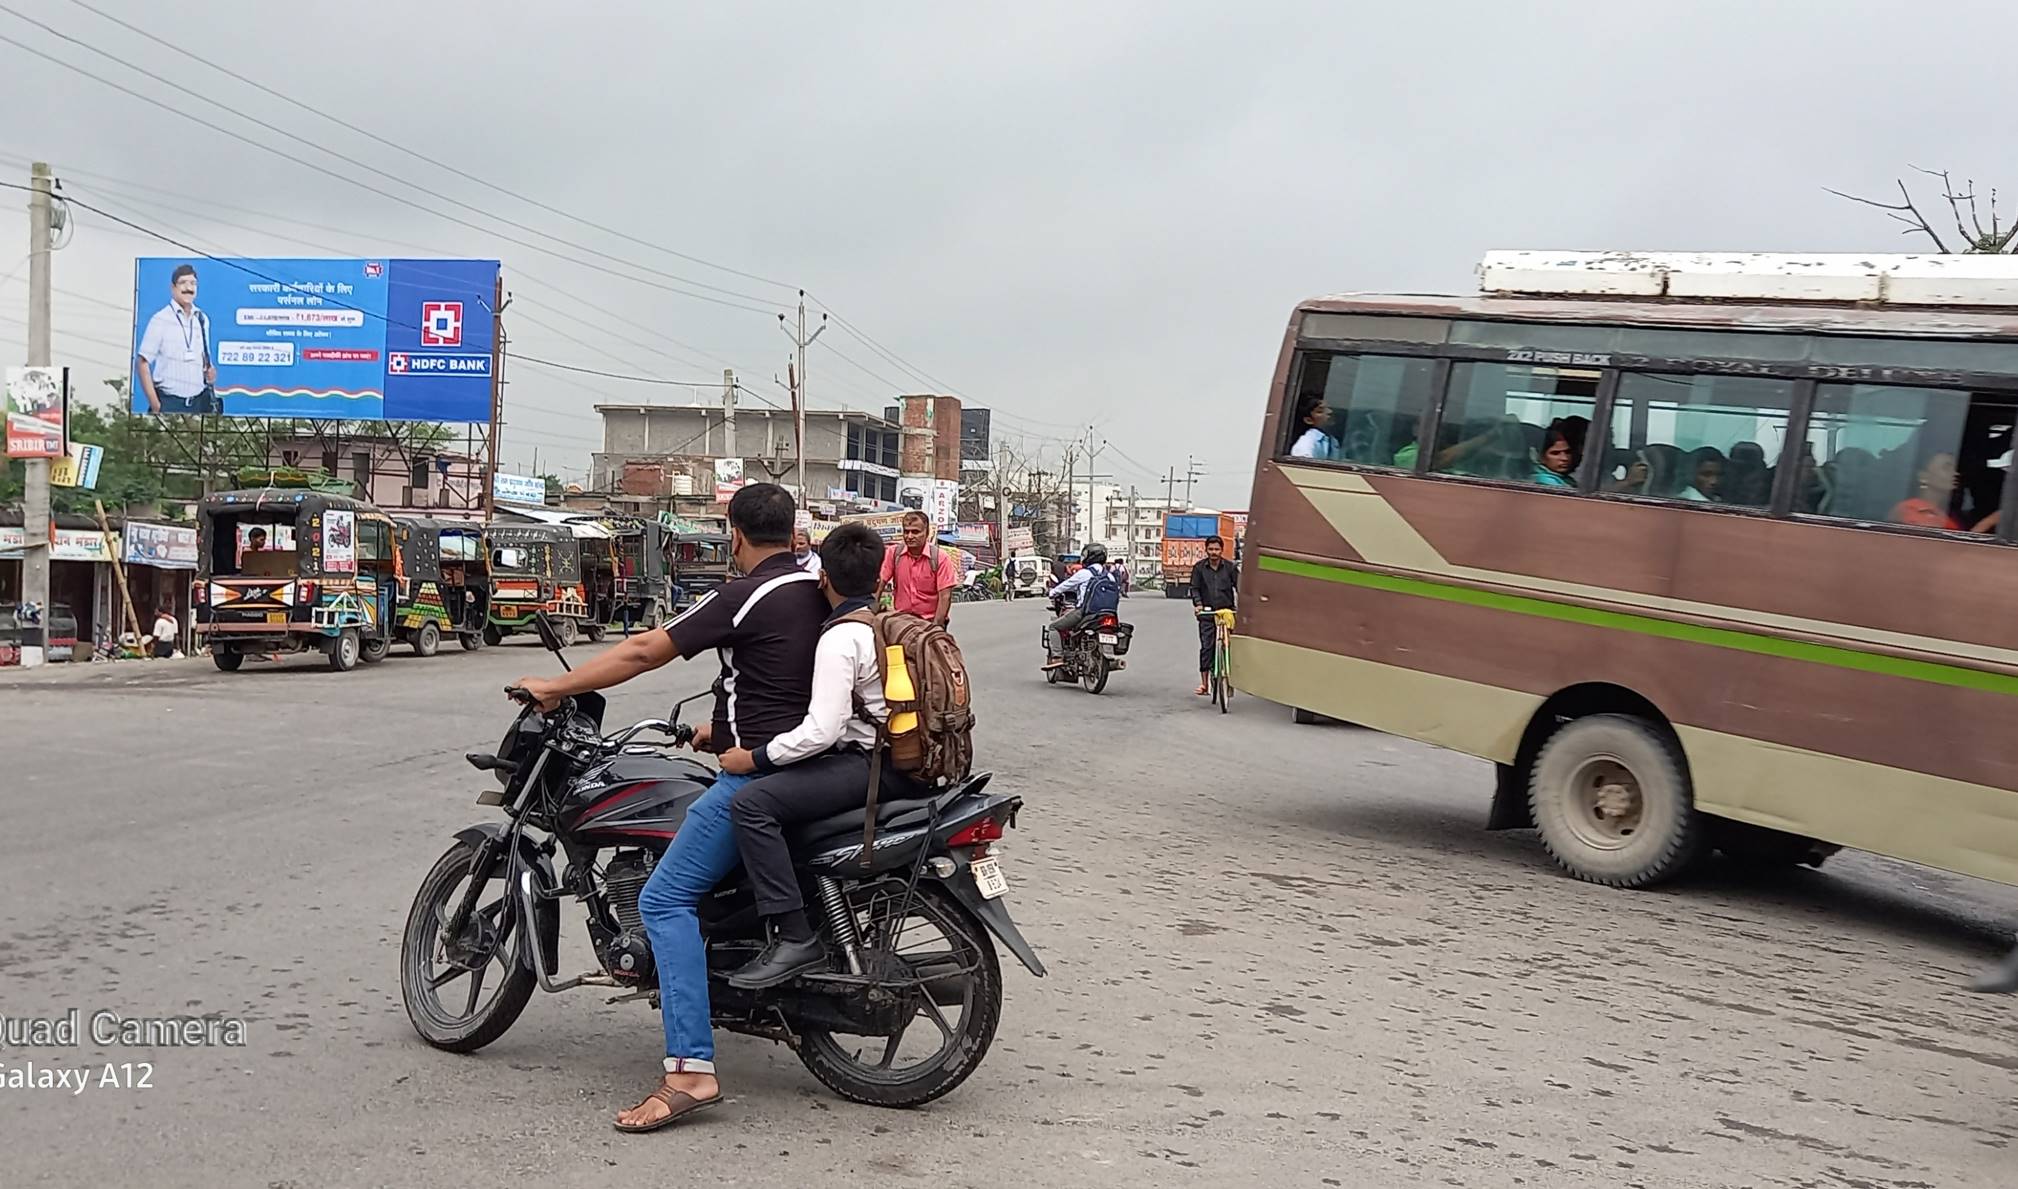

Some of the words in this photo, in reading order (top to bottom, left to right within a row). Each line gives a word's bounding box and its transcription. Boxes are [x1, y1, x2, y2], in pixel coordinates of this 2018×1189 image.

[325, 282, 335, 293] के
[337, 282, 353, 295] लिए
[222, 353, 239, 362] 722
[242, 353, 255, 362] 89
[258, 353, 270, 362] 22
[273, 353, 291, 363] 321
[411, 359, 446, 371] HDFC
[449, 360, 486, 371] BANK
